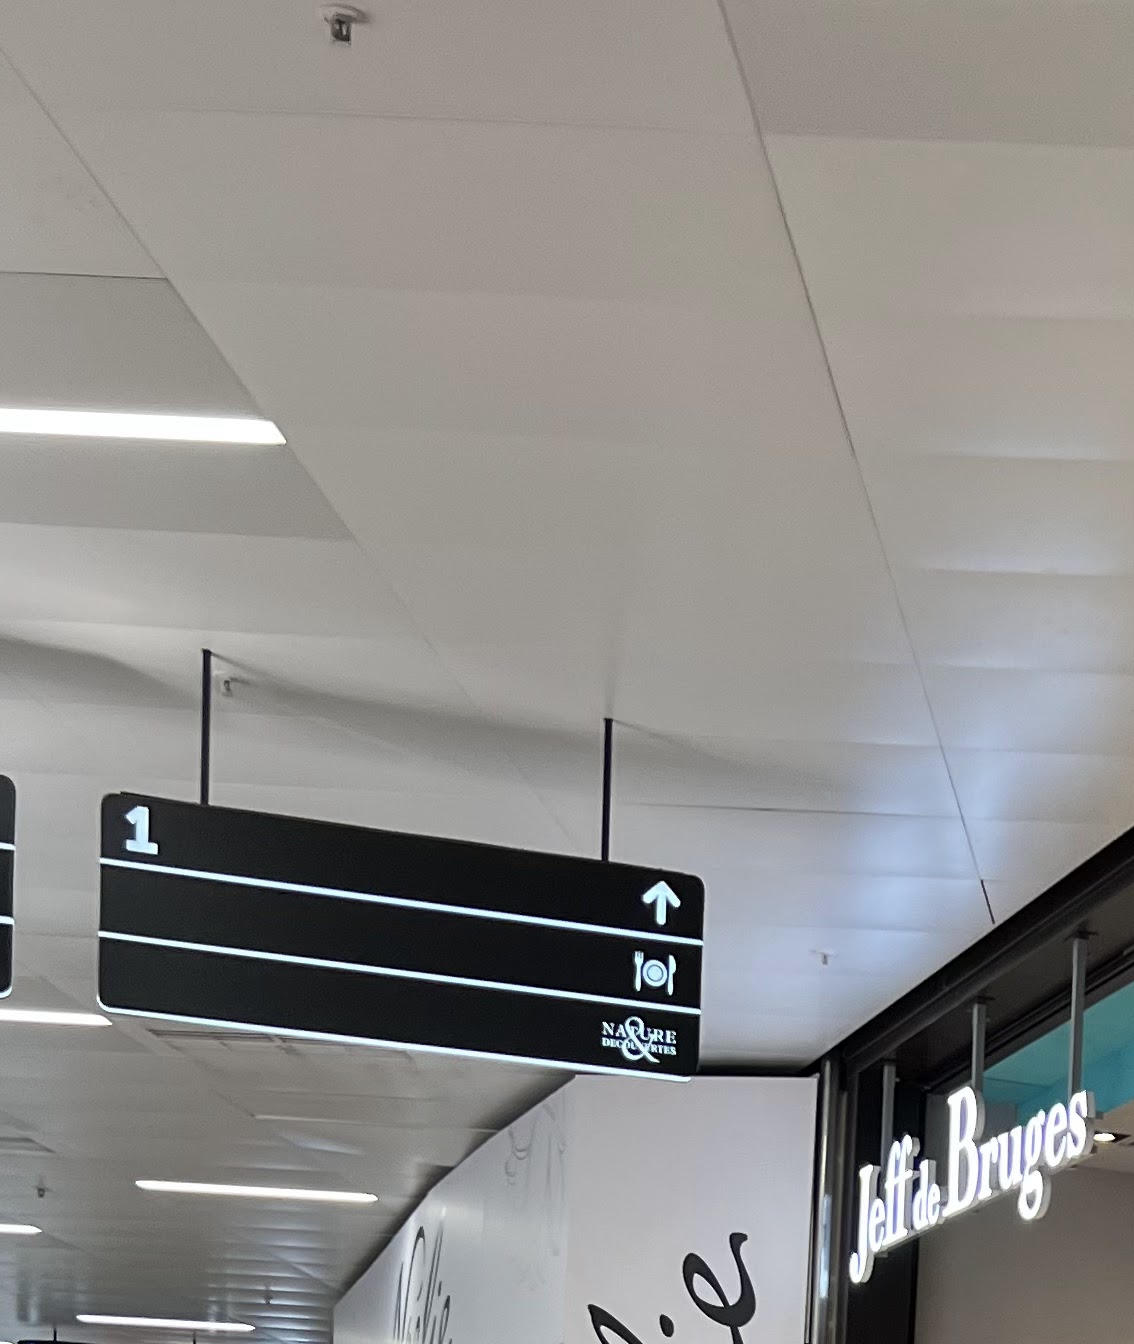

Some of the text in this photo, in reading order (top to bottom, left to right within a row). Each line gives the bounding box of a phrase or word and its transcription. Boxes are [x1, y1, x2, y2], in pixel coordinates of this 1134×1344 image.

[125, 805, 158, 855] 1
[849, 1085, 1091, 1284] Jeff de Bruges
